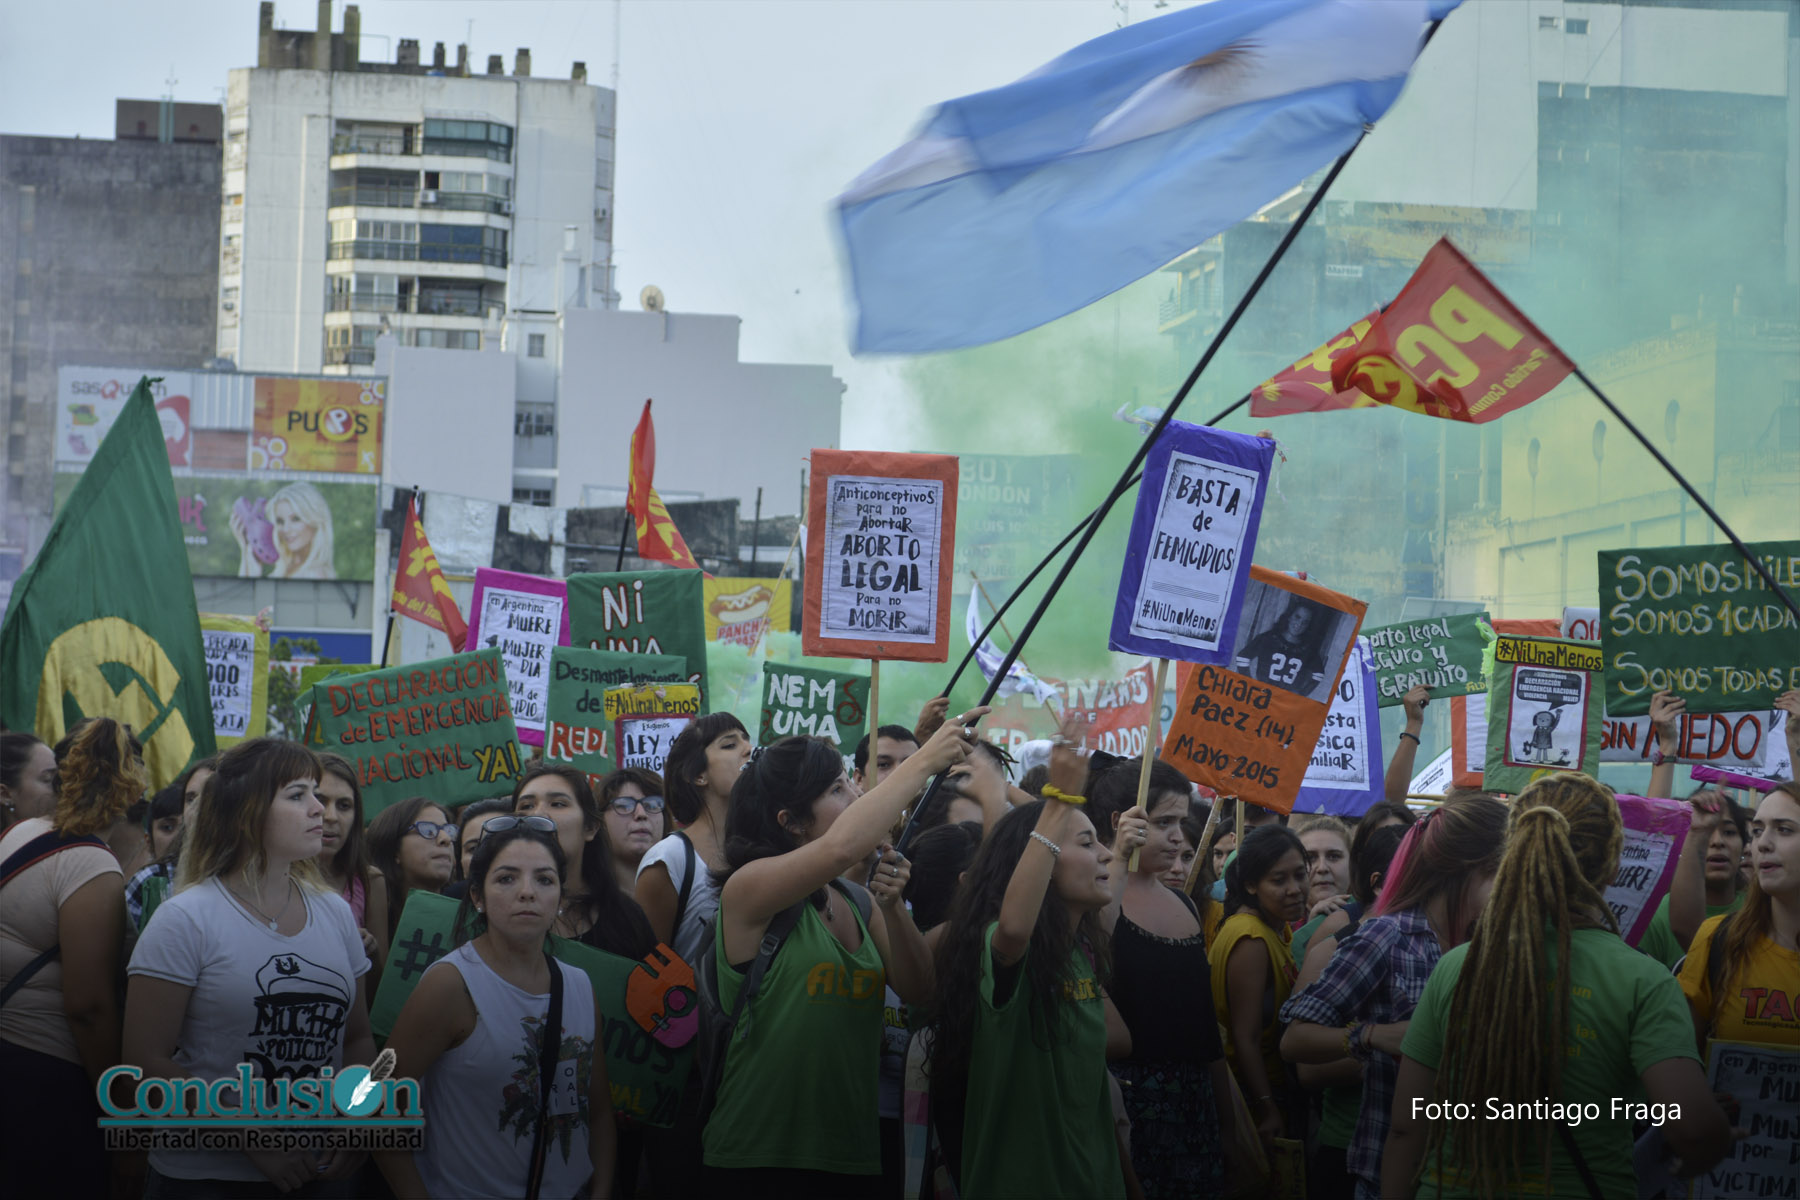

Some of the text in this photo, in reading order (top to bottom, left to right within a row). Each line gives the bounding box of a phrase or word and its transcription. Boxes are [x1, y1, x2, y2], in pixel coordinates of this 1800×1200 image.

[1175, 474, 1241, 516] BASTA
[856, 504, 907, 516] para no
[1192, 510, 1213, 532] de
[840, 534, 920, 561] ABORTO
[1153, 531, 1235, 574] FEMICIDIOS
[841, 559, 923, 594] LEGAL
[1615, 555, 1742, 601] SOMOS
[501, 598, 544, 613] Argentina
[602, 579, 644, 631] Ni
[889, 596, 902, 606] no
[1142, 599, 1217, 632] #NiUnaMenos
[507, 613, 552, 634] MUERE
[849, 608, 908, 630] MORIR
[1408, 618, 1452, 648] legal
[1609, 602, 1713, 637] SOMOS
[502, 639, 545, 659] MUJER
[1499, 640, 1602, 671] #NiUnaMenos
[520, 659, 540, 678] DIA
[1268, 653, 1302, 685] 23
[1613, 651, 1712, 695] SOMOS
[1713, 665, 1784, 695] TODAS
[527, 689, 538, 700] de
[576, 689, 600, 713] de
[768, 673, 836, 712] NEM
[340, 723, 367, 744] de
[772, 709, 842, 745] UMA
[627, 734, 660, 755] LEY
[472, 740, 523, 783] YA!
[1232, 756, 1280, 789] 2015
[1741, 1142, 1774, 1162] por
[1708, 1170, 1797, 1198] VICTIMA
